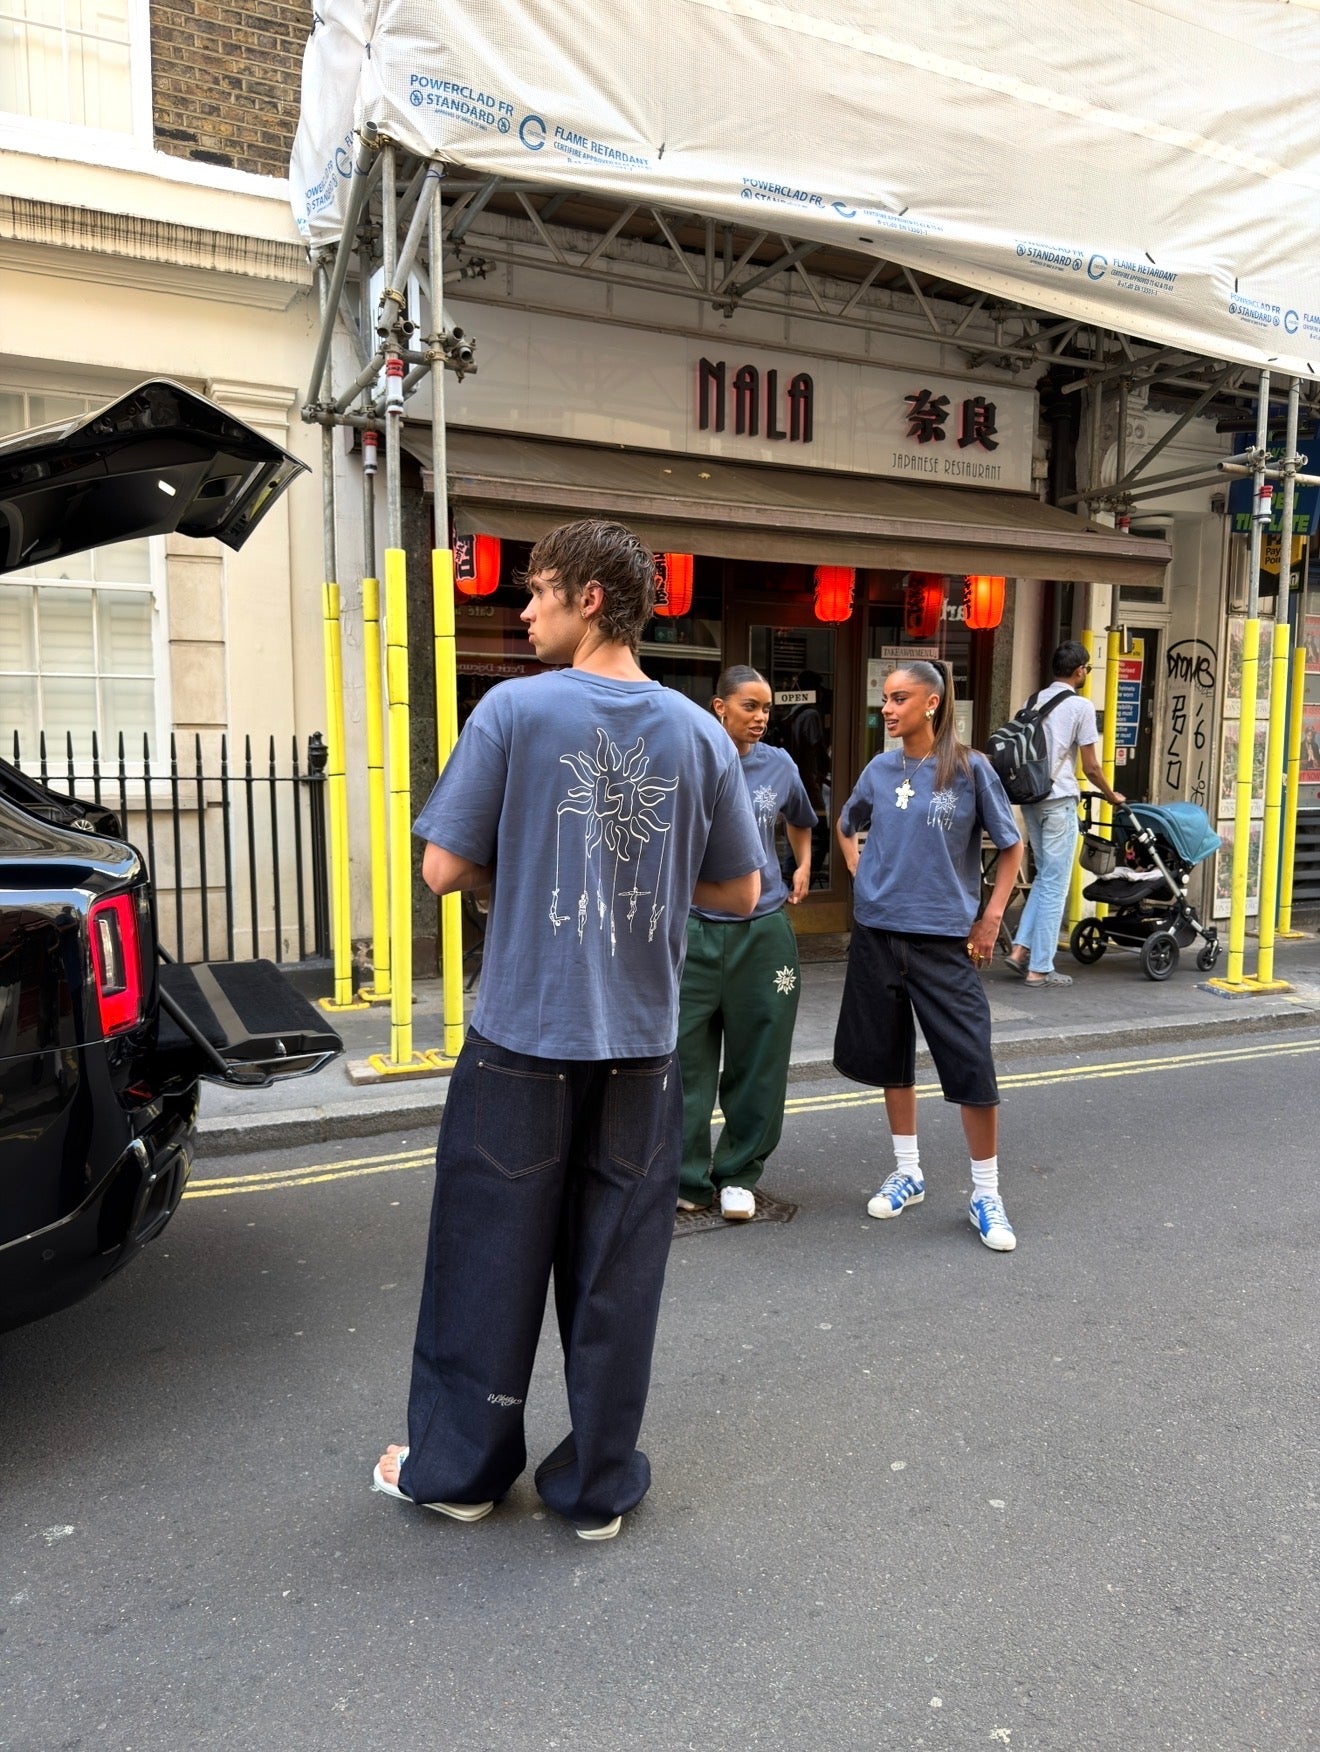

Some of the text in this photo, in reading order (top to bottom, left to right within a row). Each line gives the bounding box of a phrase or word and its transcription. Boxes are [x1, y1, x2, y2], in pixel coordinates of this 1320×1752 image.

[410, 74, 514, 117] POWERCLAD FR
[427, 93, 495, 125] STANDARD
[555, 126, 588, 149] FLAME
[591, 141, 648, 166] RETARDANT
[1027, 247, 1072, 267] STANDARD
[1113, 258, 1178, 283] FLAME RETARDANT
[1237, 305, 1272, 323] STANDARD
[1271, 305, 1280, 314] FR
[699, 357, 813, 443] NALA
[904, 389, 999, 451] 奈良
[892, 453, 1001, 480] JAPANESE RESTAURANT
[781, 693, 809, 702] OPEN
